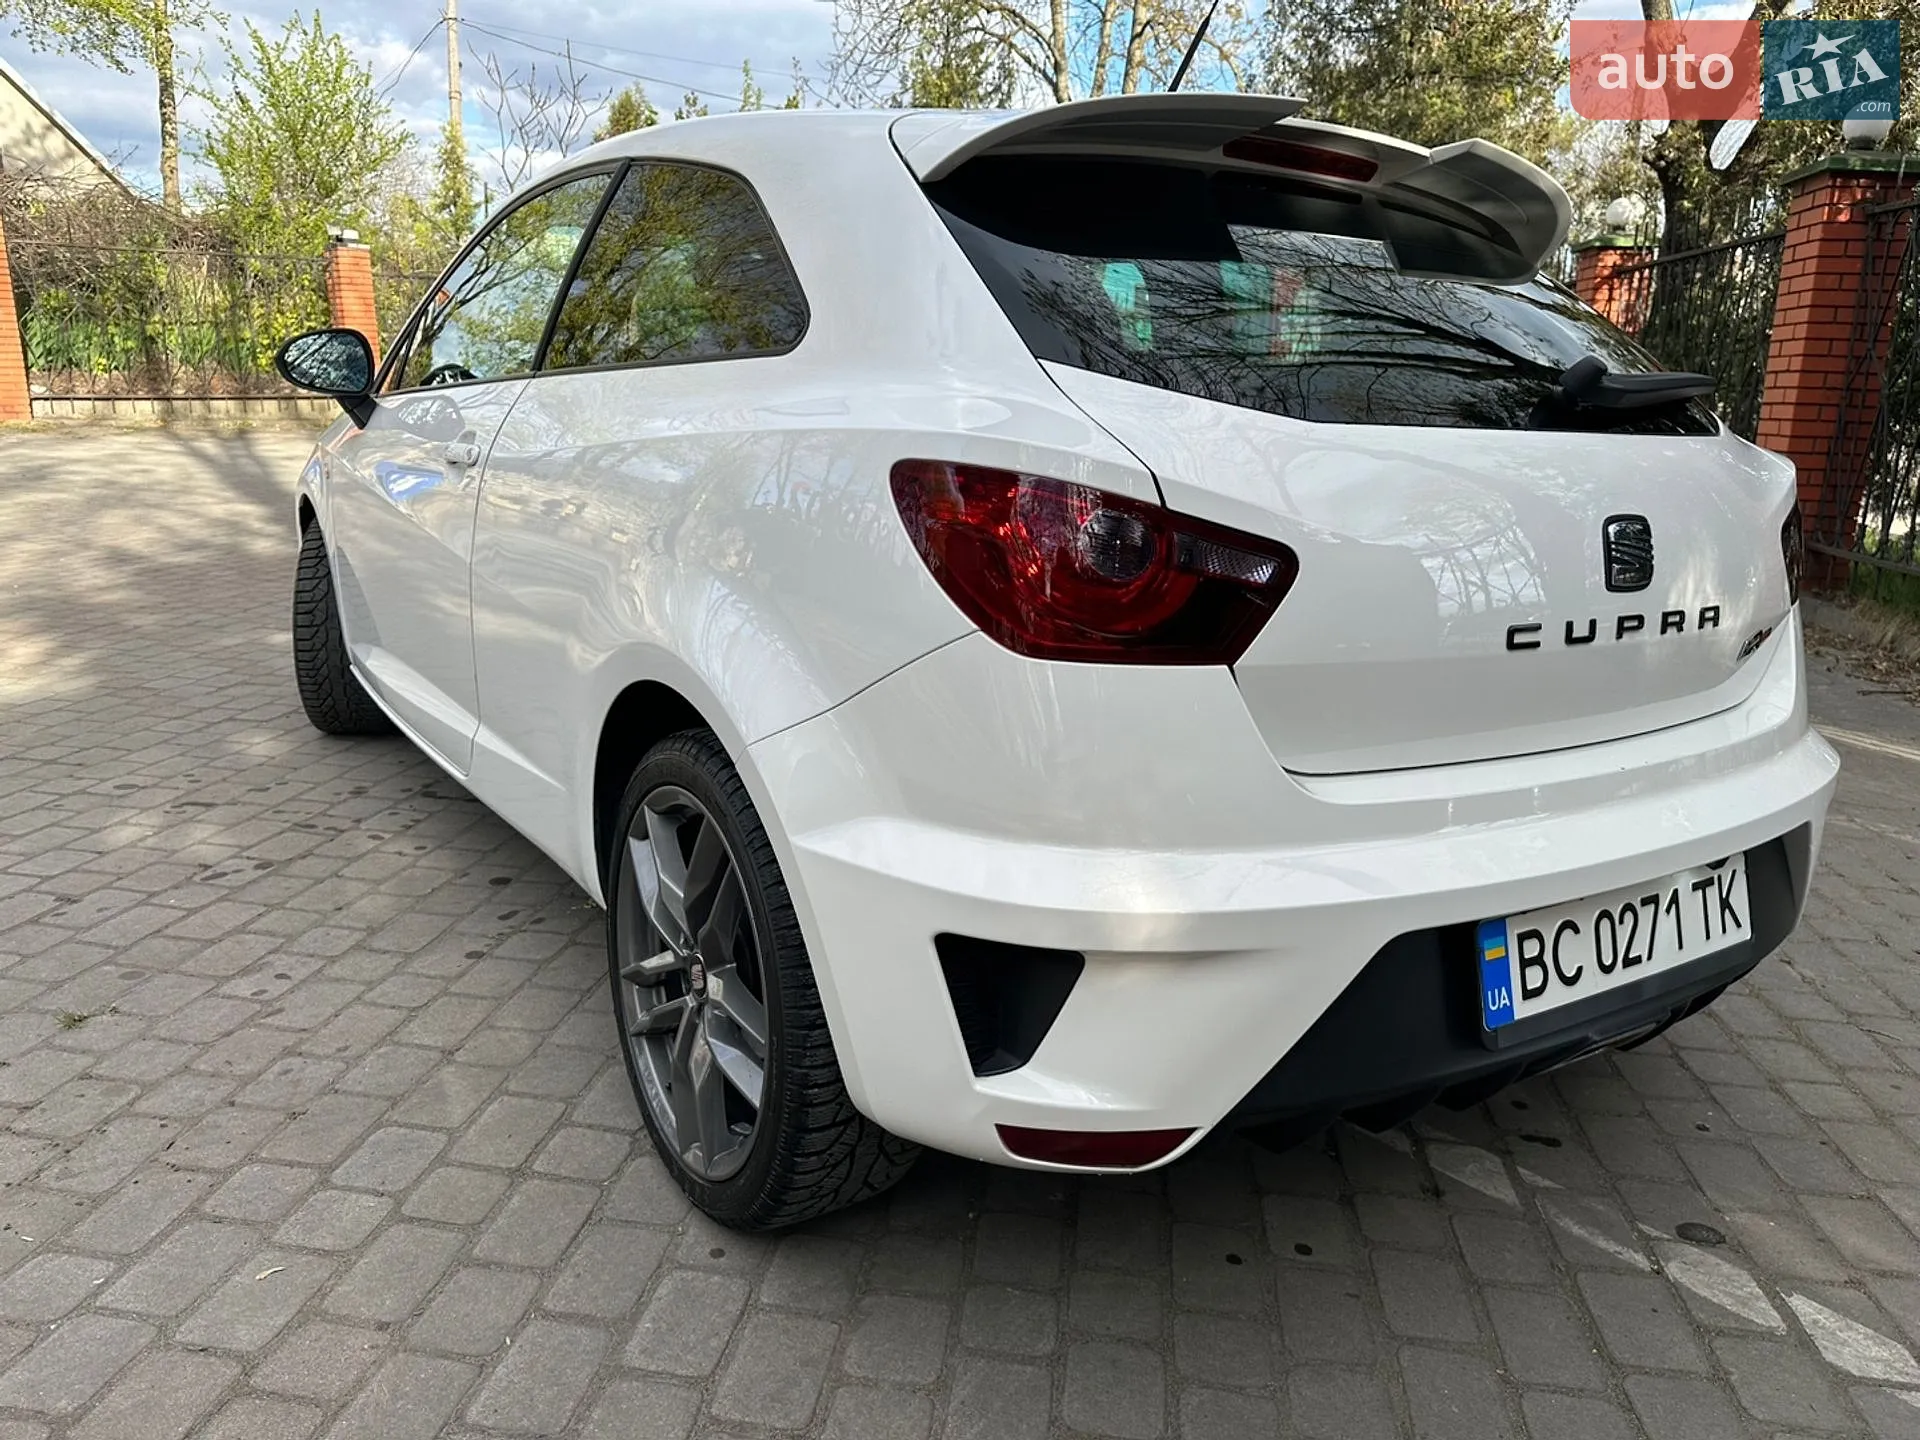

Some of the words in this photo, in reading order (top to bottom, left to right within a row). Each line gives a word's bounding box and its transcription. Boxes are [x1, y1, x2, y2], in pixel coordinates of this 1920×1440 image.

[1506, 605, 1720, 652] CUPRA
[1516, 918, 1584, 1001] BC
[1594, 887, 1683, 975] 0271
[1691, 869, 1742, 940] TK
[1488, 986, 1510, 1011] UA
